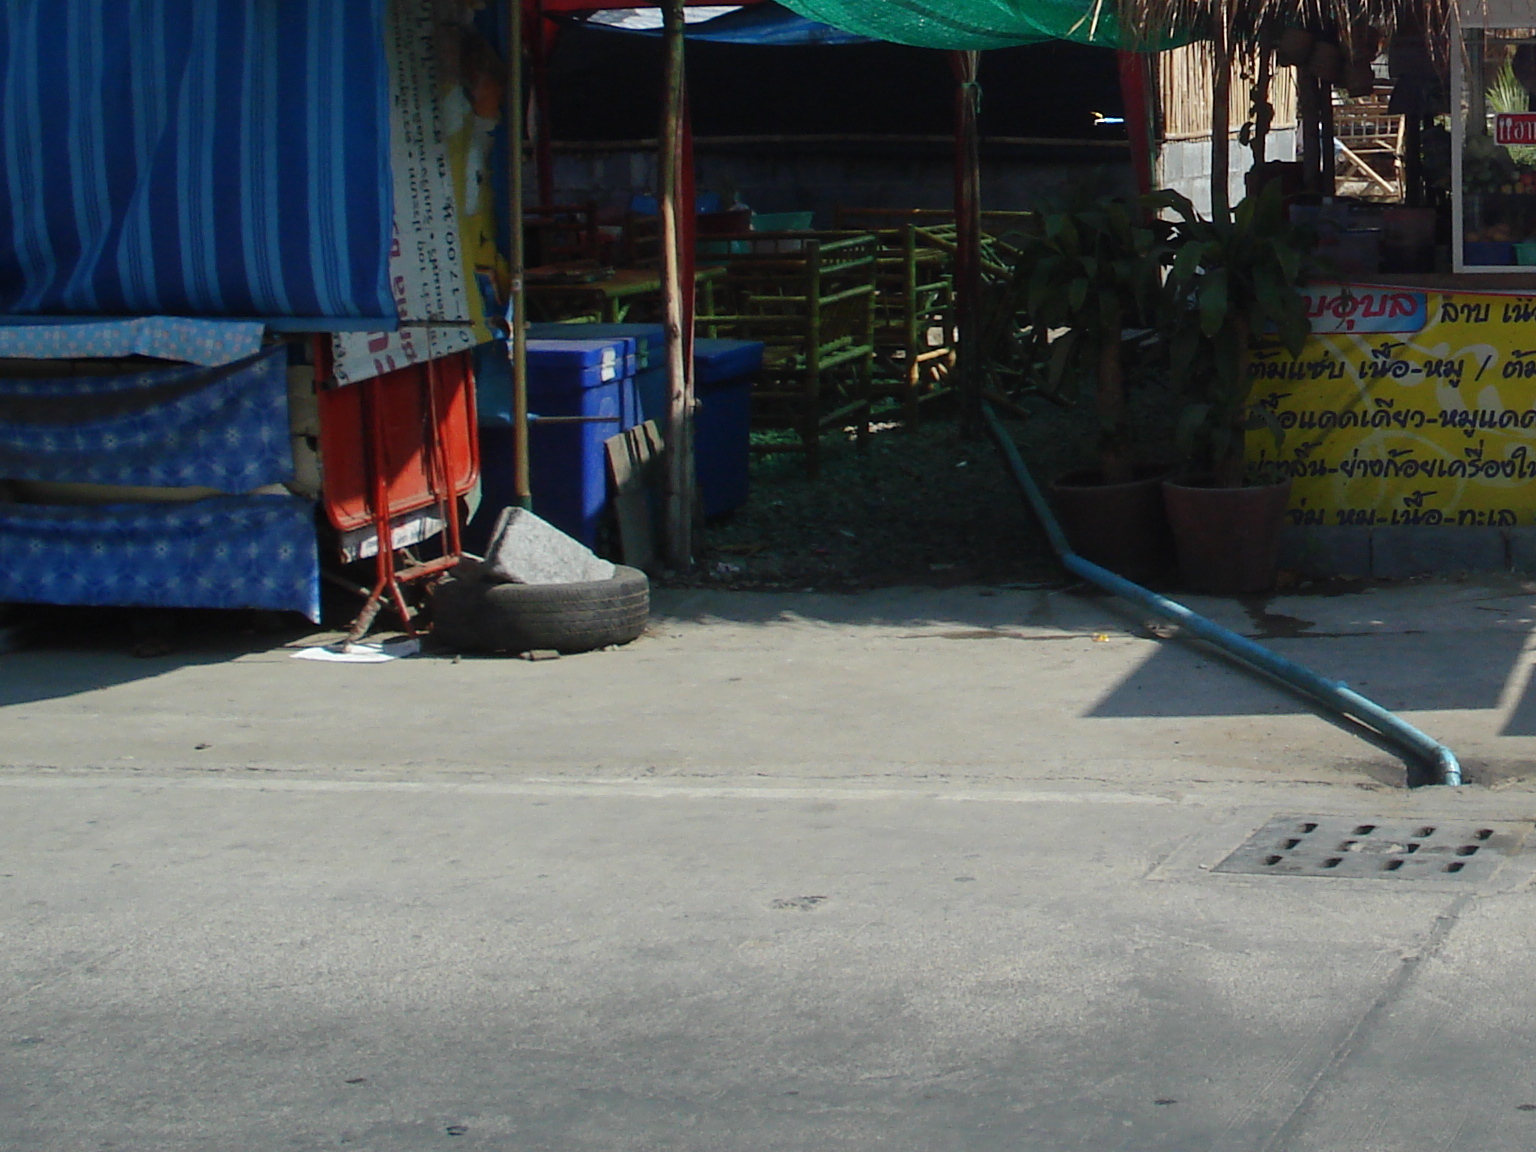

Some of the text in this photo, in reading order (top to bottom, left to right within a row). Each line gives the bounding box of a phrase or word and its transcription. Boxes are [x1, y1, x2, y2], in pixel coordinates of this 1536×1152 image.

[1441, 302, 1490, 324] ลาบ
[1360, 342, 1462, 388] เนื้อ-หมู
